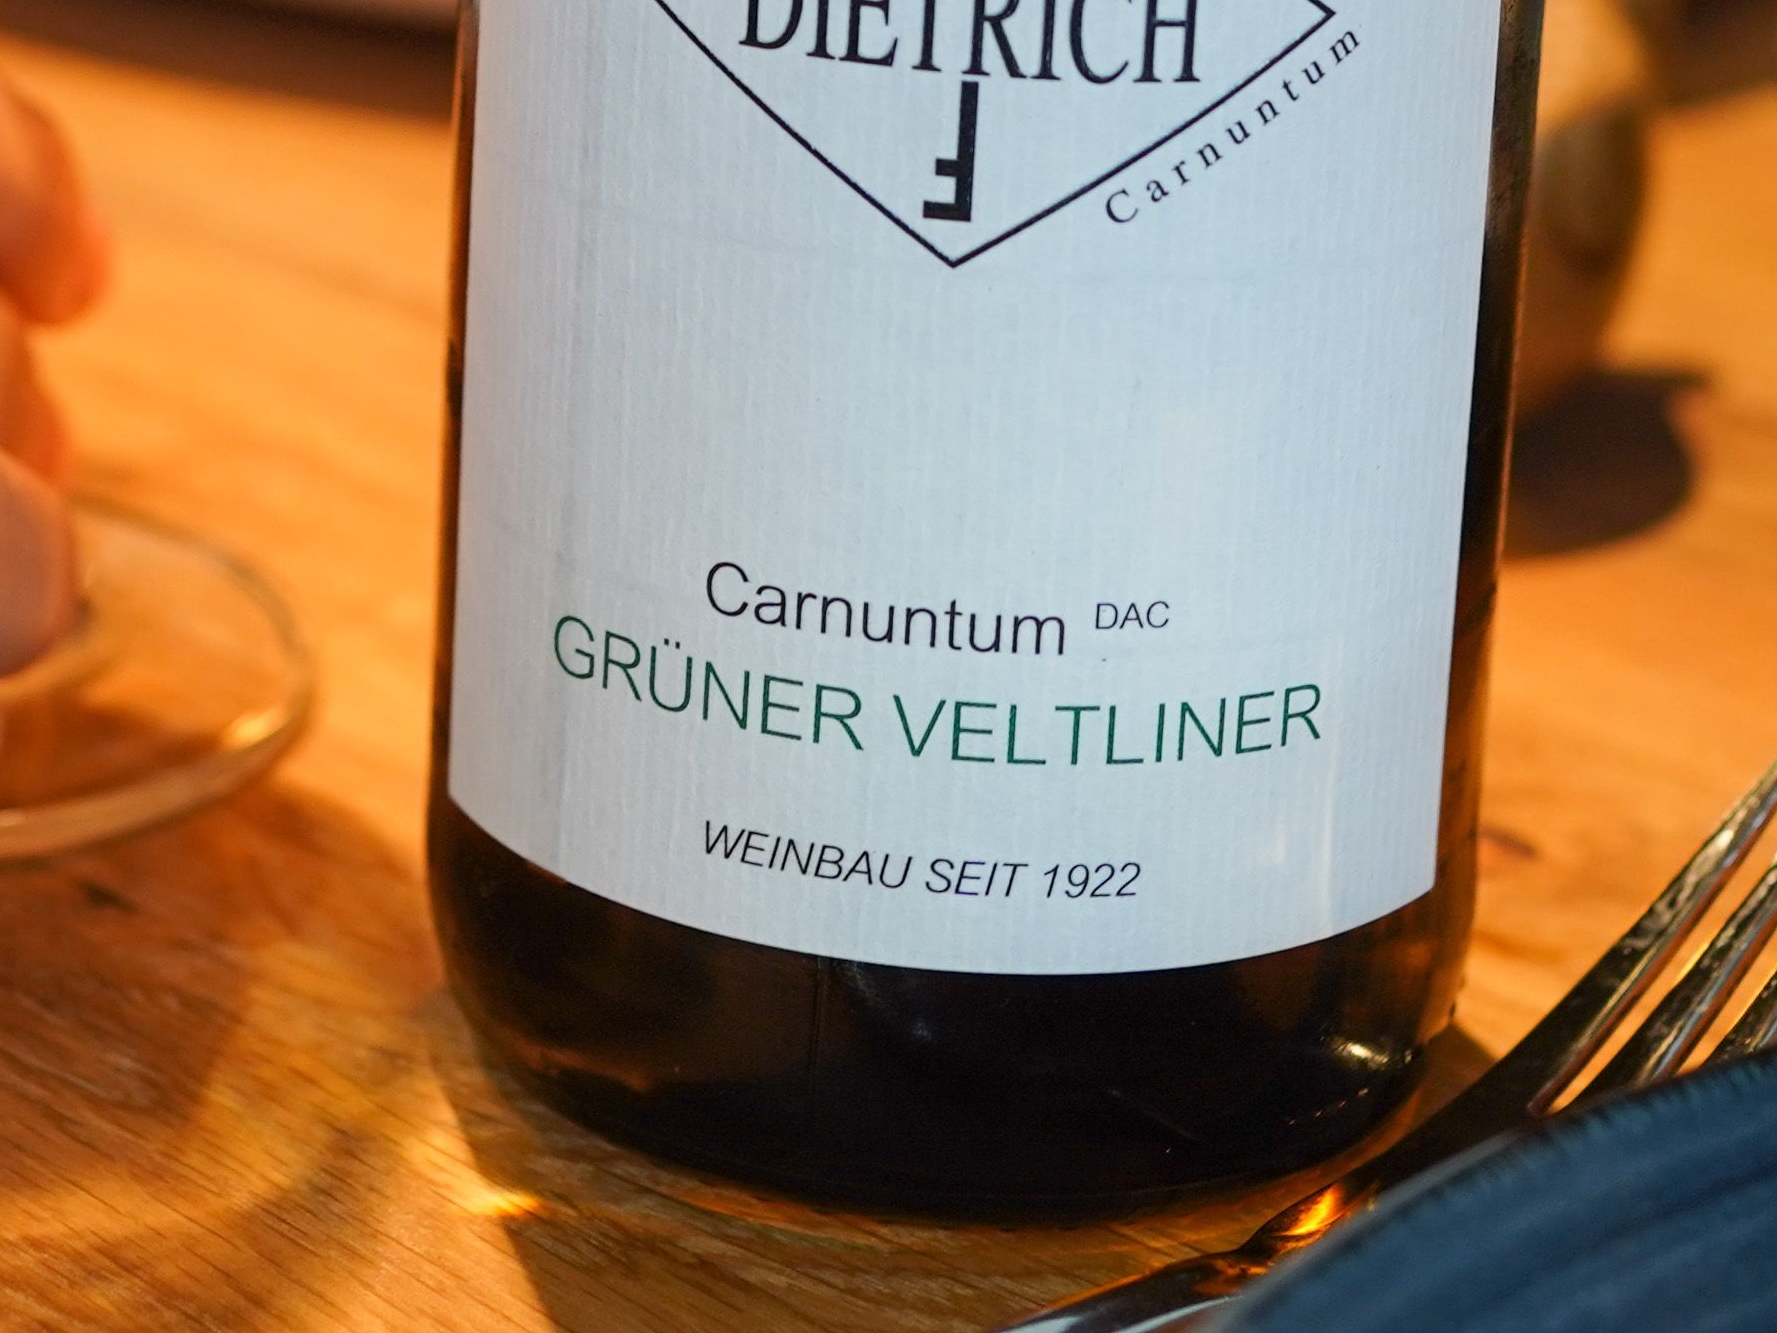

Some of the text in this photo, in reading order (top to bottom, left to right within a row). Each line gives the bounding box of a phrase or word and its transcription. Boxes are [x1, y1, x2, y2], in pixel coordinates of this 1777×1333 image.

[1104, 26, 1362, 228] Carnuntum
[705, 560, 1171, 656] Carnuntum DAC
[553, 614, 1324, 766] GRÜNER VELTLINER
[703, 819, 1142, 901] WEINBAU SEIT 1922
